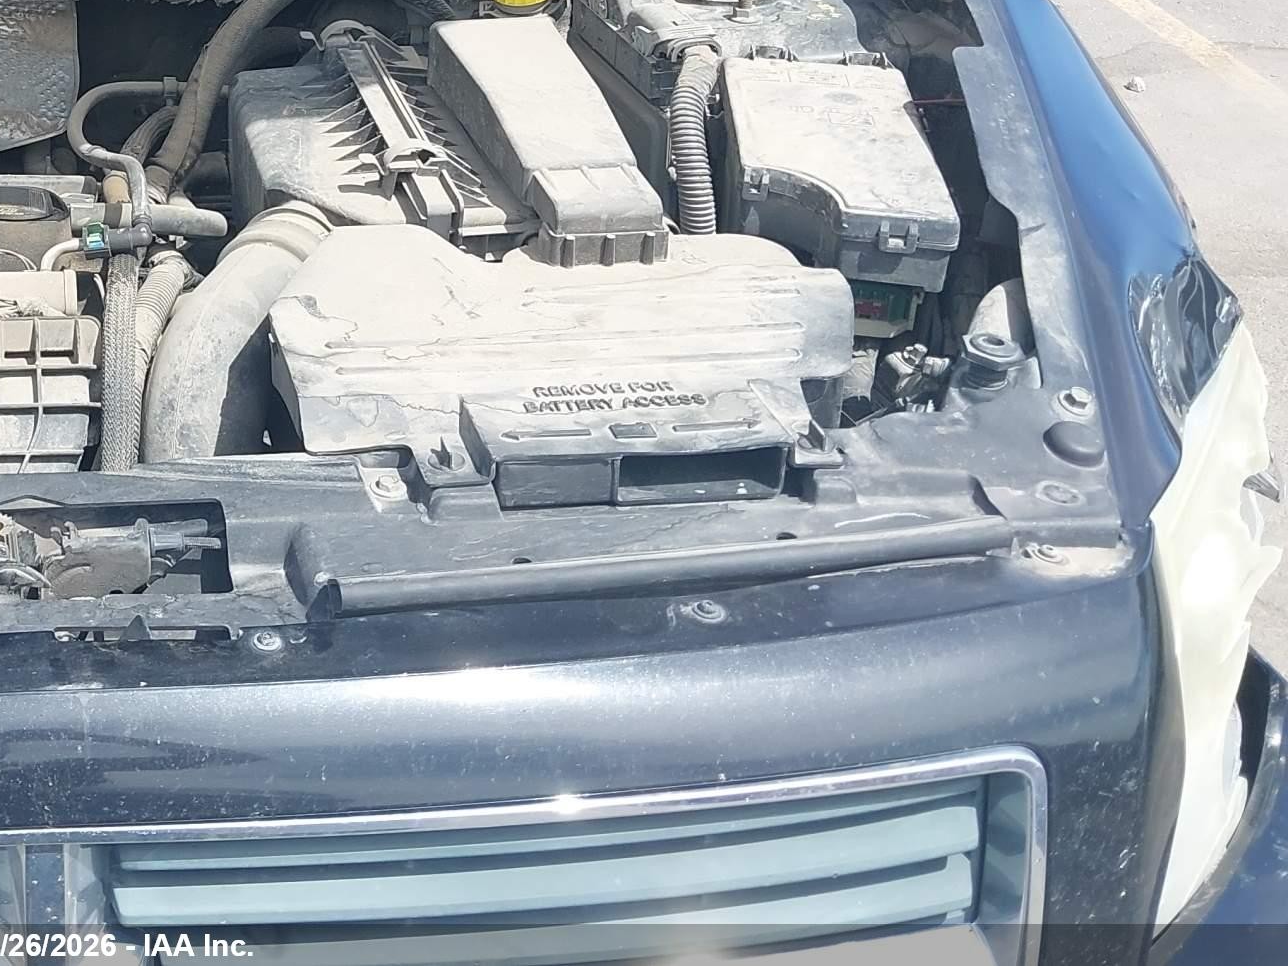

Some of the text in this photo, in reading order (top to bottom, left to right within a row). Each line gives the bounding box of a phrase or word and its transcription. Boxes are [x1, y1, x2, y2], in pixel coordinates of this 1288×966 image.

[532, 380, 675, 398] REMOVE FOR
[523, 393, 707, 414] BATTERY ACCESS
